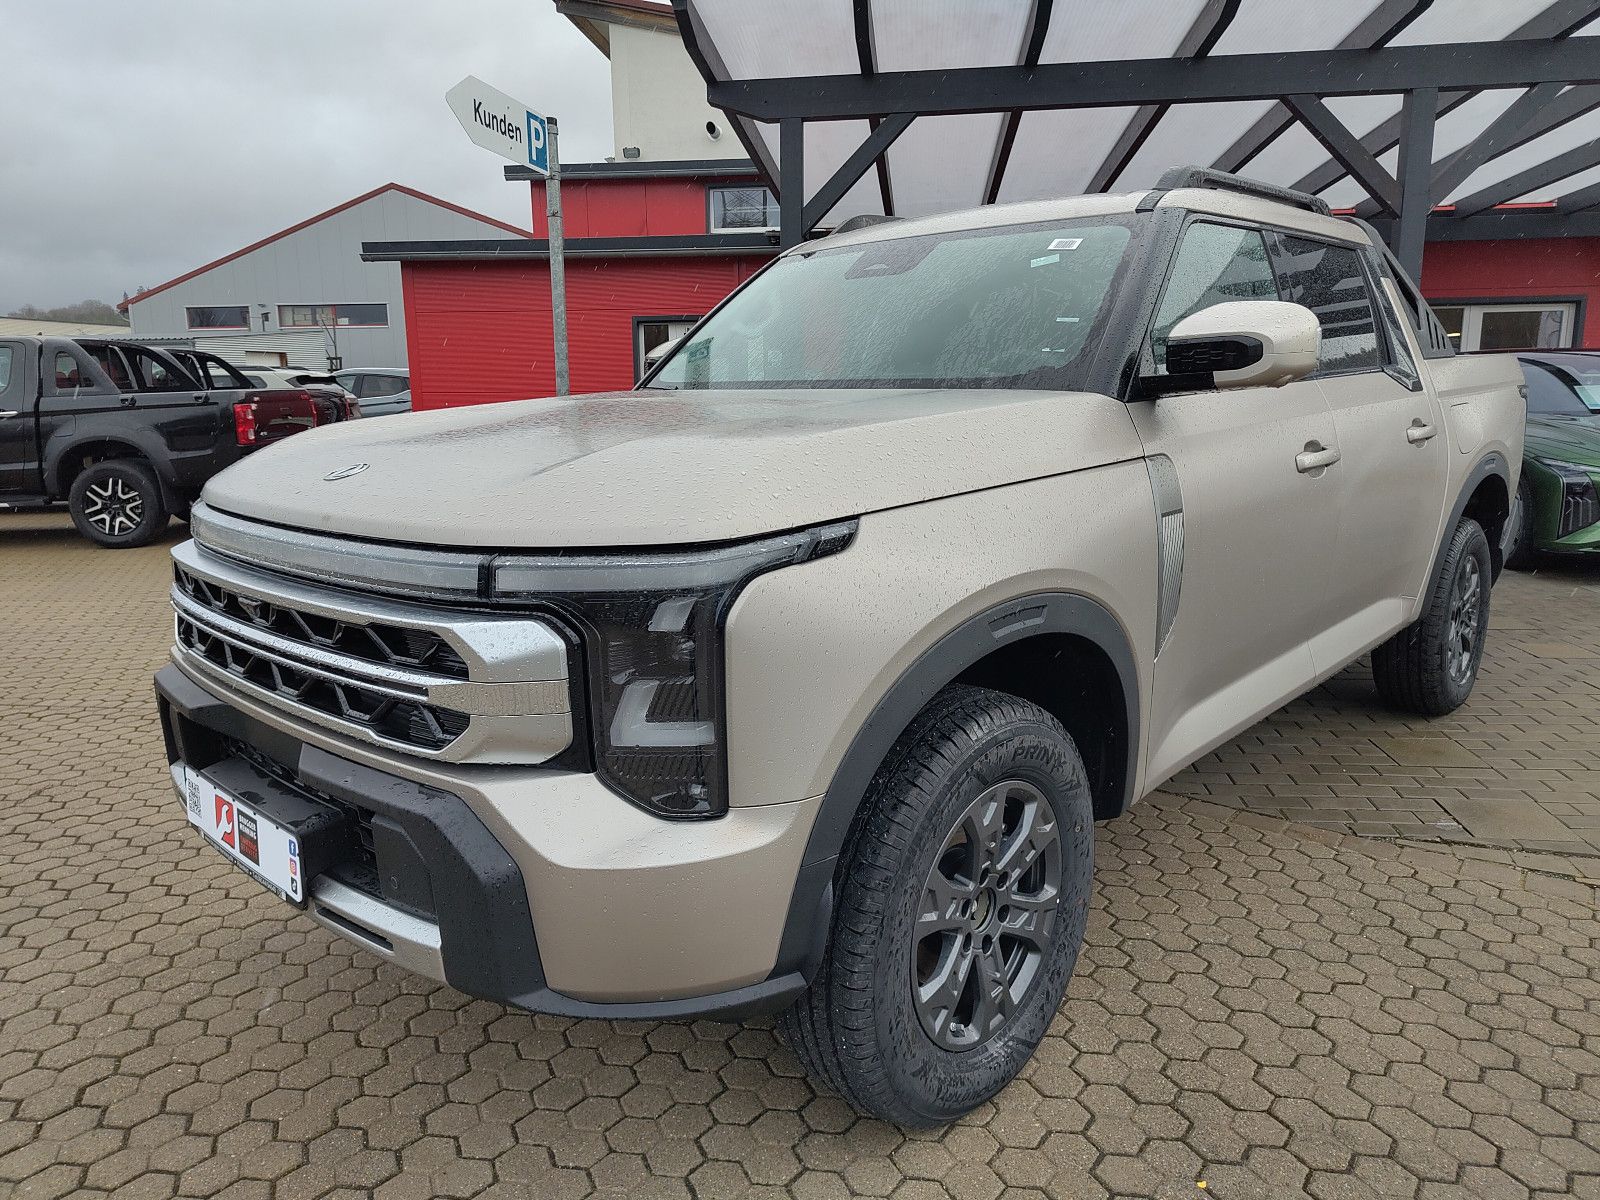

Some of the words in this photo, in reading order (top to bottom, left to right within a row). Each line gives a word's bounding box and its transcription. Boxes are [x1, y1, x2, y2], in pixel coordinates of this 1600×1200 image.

[473, 98, 522, 143] Kunden
[529, 118, 544, 160] P
[1011, 744, 1067, 773] PRINX
